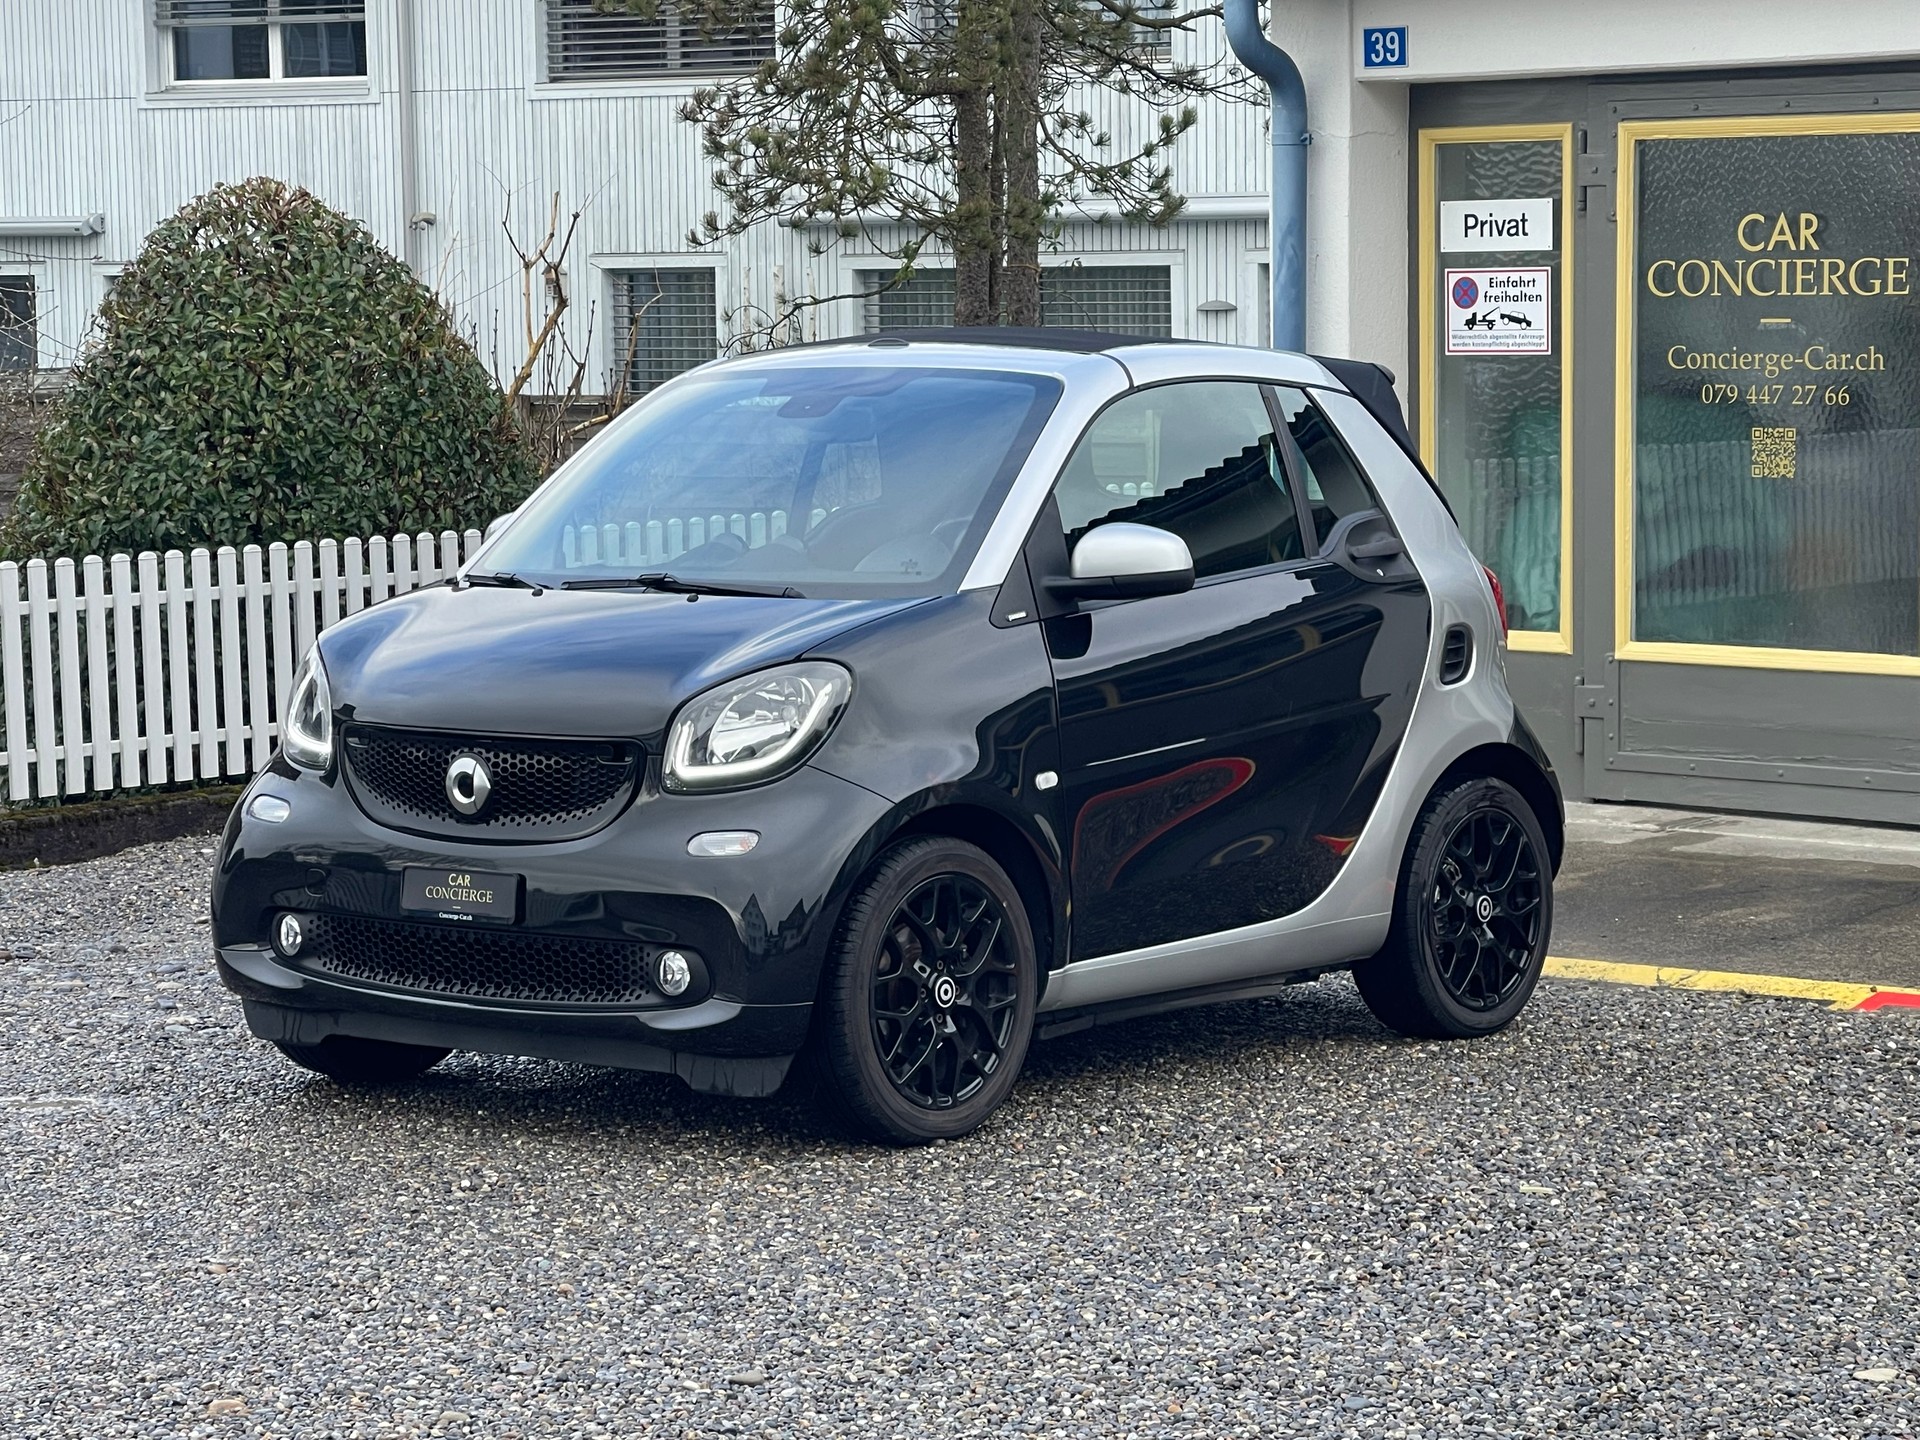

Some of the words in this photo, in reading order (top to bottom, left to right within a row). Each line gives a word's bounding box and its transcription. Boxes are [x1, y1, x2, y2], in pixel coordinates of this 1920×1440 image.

[1371, 31, 1399, 63] 39
[1464, 213, 1528, 238] Privat
[1737, 212, 1819, 252] CAR
[1489, 276, 1536, 288] Einfahrt
[1647, 257, 1910, 297] CONCIERGE
[1484, 290, 1542, 303] freihalten
[1667, 345, 1885, 378] Concierge-Car.ch
[1701, 384, 1738, 404] 079
[1746, 384, 1784, 404] 447
[1792, 385, 1816, 405] 27
[1824, 385, 1850, 405] 66
[448, 873, 471, 887] CAR
[425, 886, 493, 903] CONCIERGE
